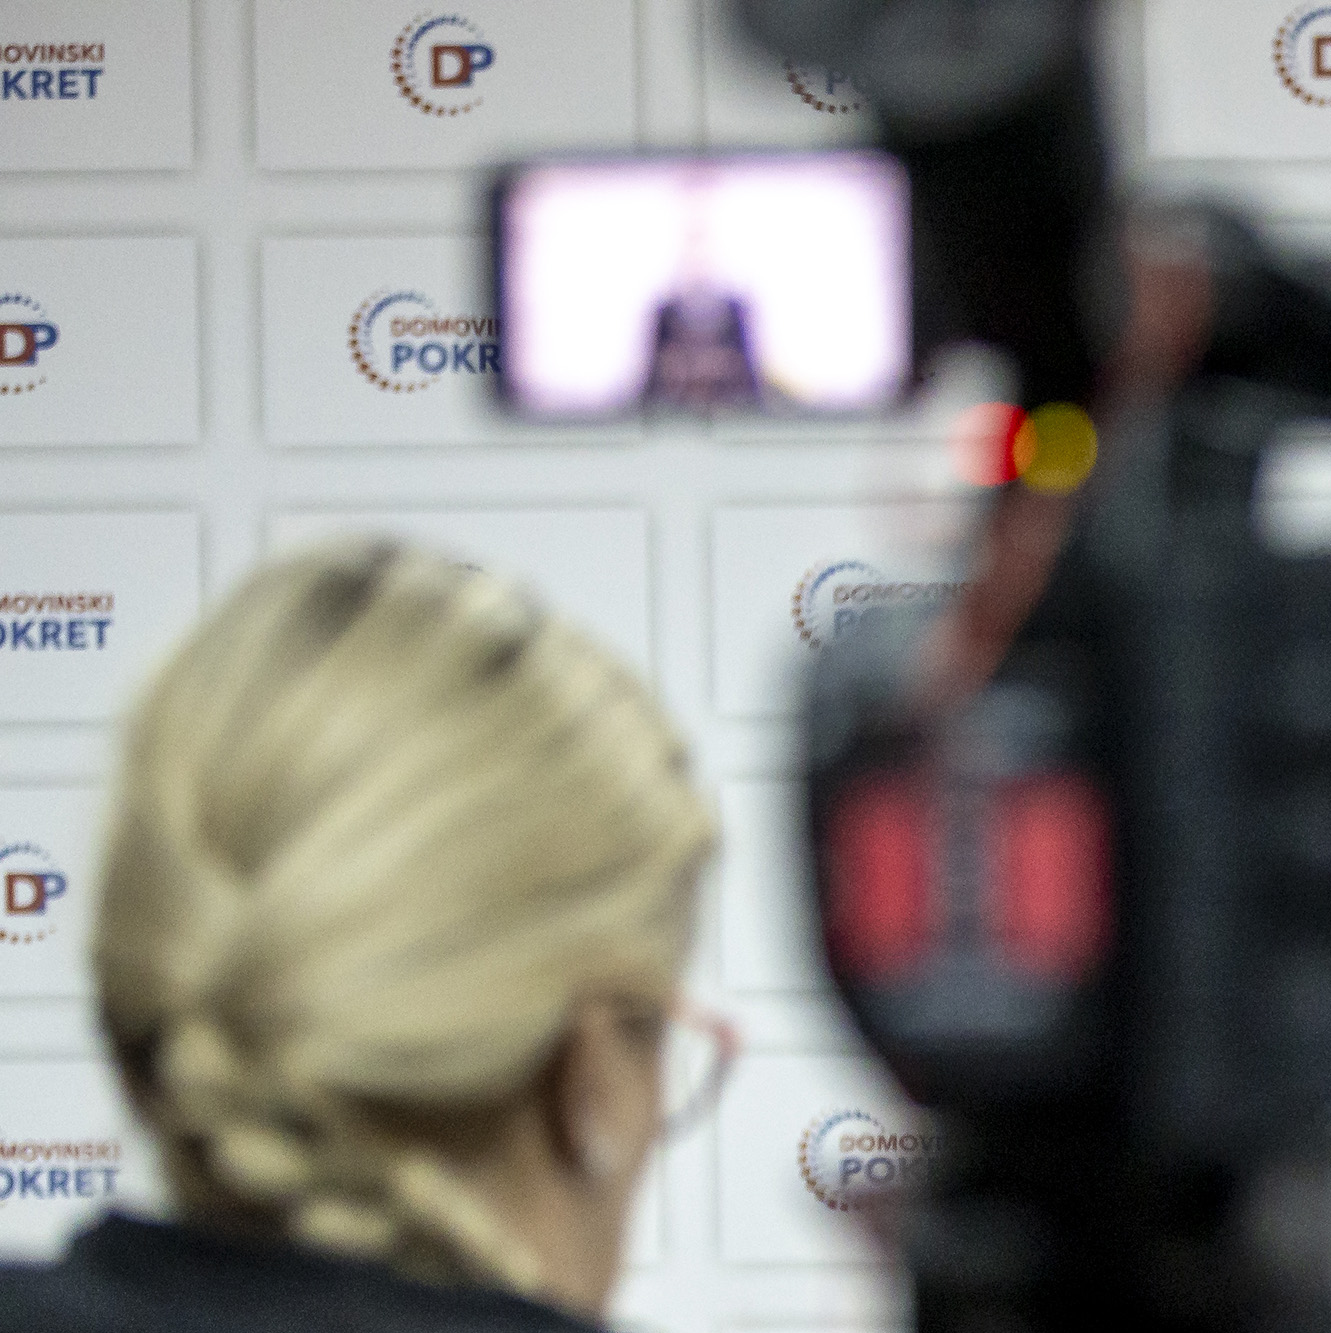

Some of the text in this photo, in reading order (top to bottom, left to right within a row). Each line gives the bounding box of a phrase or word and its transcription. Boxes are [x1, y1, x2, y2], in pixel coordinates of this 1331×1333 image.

[0, 44, 105, 63] OVINSKI
[431, 45, 496, 87] DP
[1, 68, 103, 100] KRET
[390, 316, 500, 337] DOMOVI
[391, 342, 501, 374] POKR
[0, 618, 113, 650] KRET
[5, 872, 67, 916] DP
